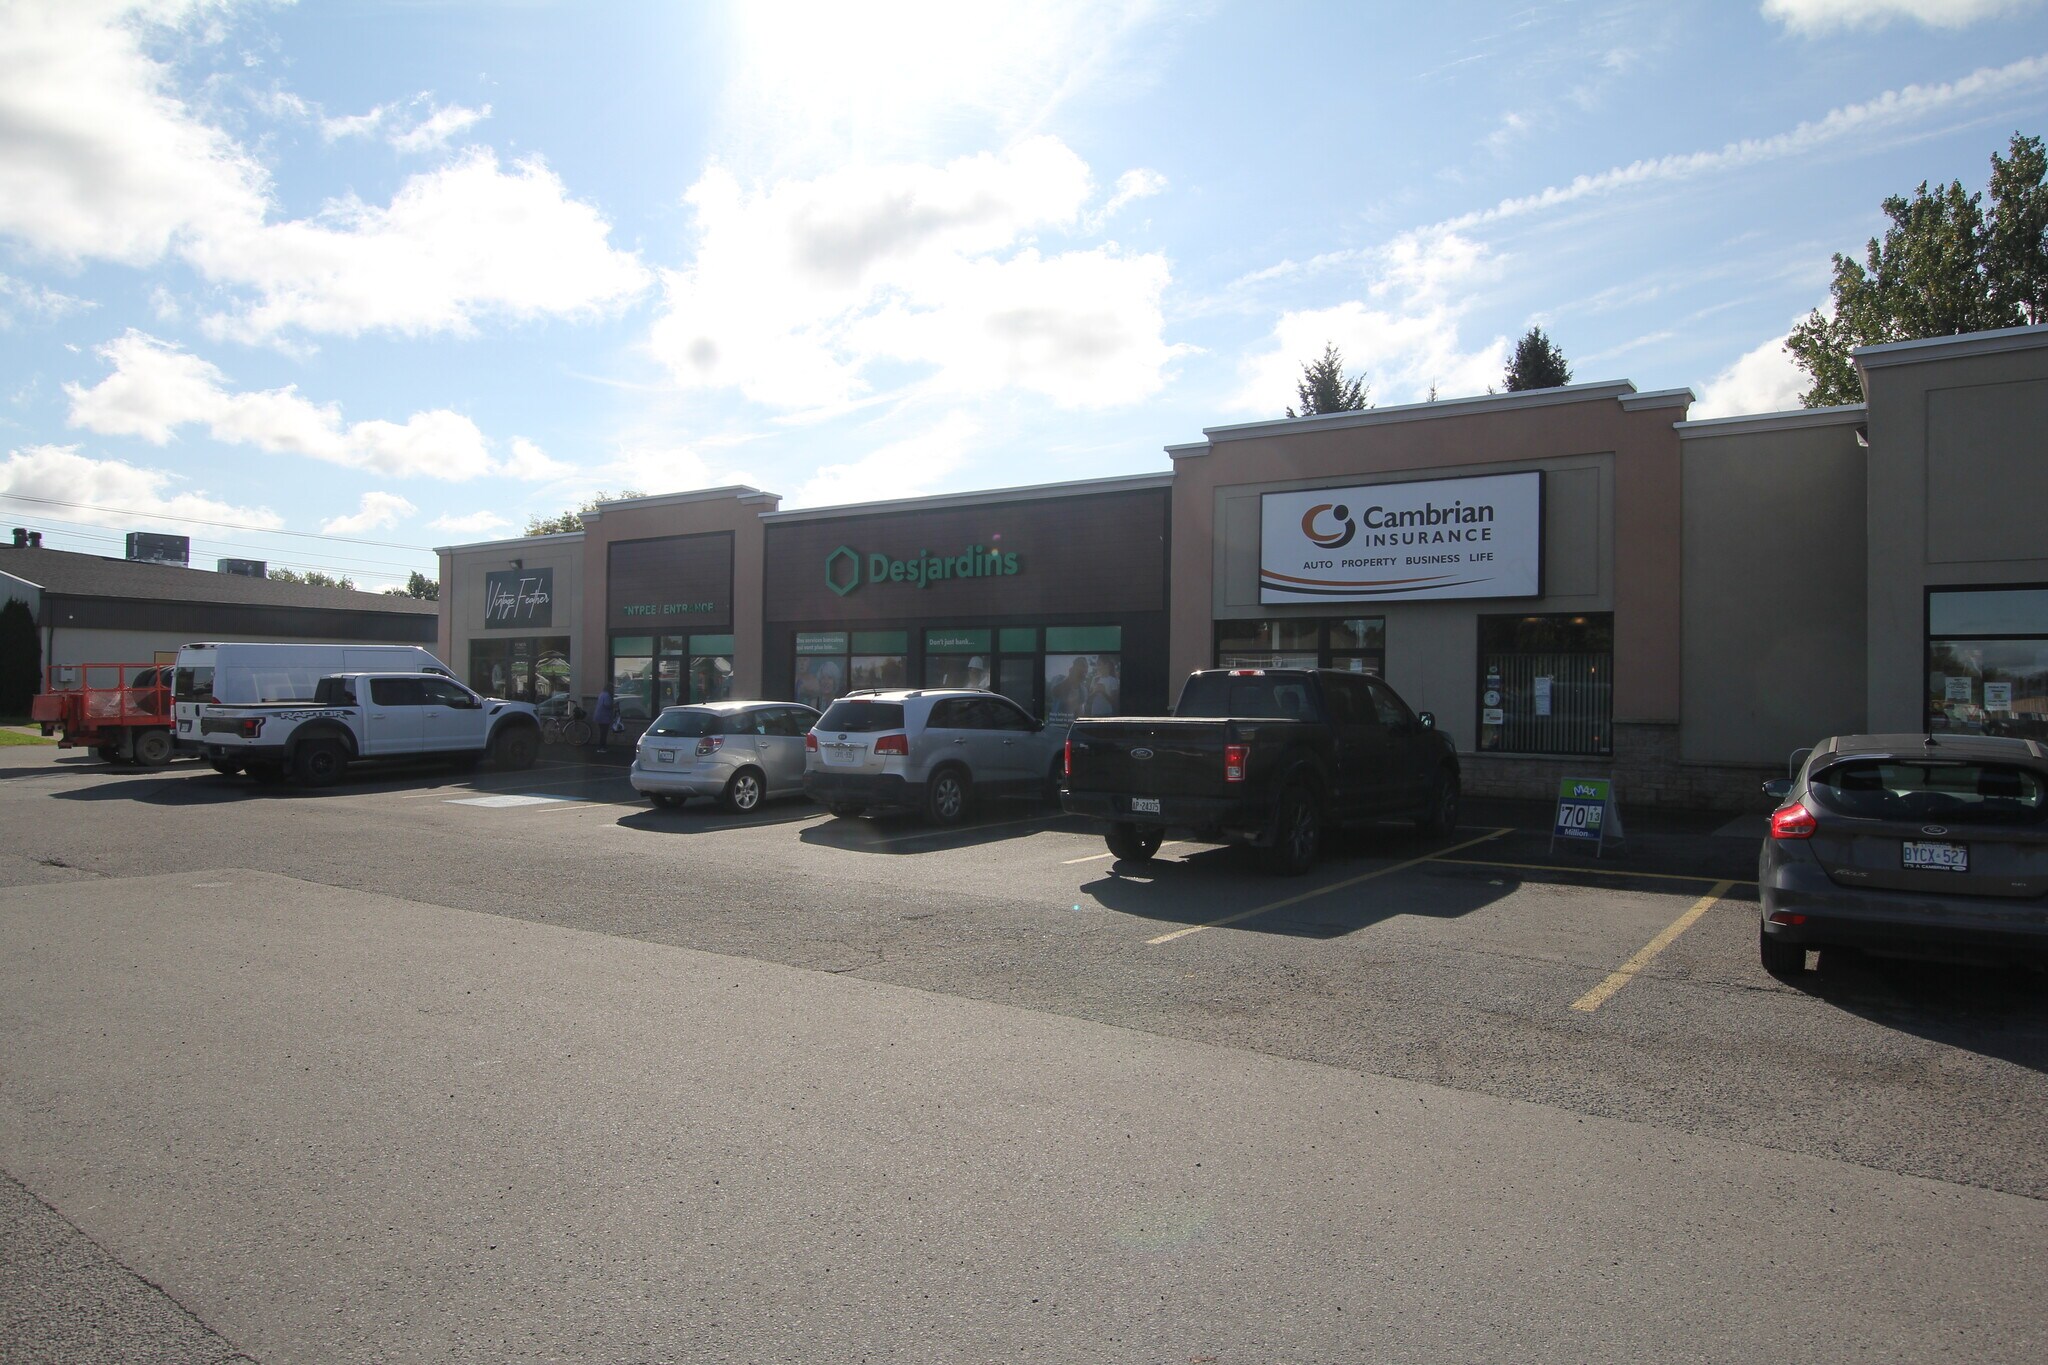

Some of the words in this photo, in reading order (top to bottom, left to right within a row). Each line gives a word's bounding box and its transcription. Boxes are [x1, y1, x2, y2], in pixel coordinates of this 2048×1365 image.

[1363, 500, 1494, 529] Cambrian
[1365, 528, 1492, 547] INSURANCE
[868, 544, 1019, 589] Desjardins
[1303, 560, 1333, 570] AUTO
[1341, 557, 1397, 568] PROPERTY
[1405, 554, 1460, 565] BUSINESS
[1469, 552, 1494, 562] LIFE
[514, 577, 550, 619] Feather
[280, 710, 349, 722] RAPTOR
[1564, 828, 1588, 837] Million
